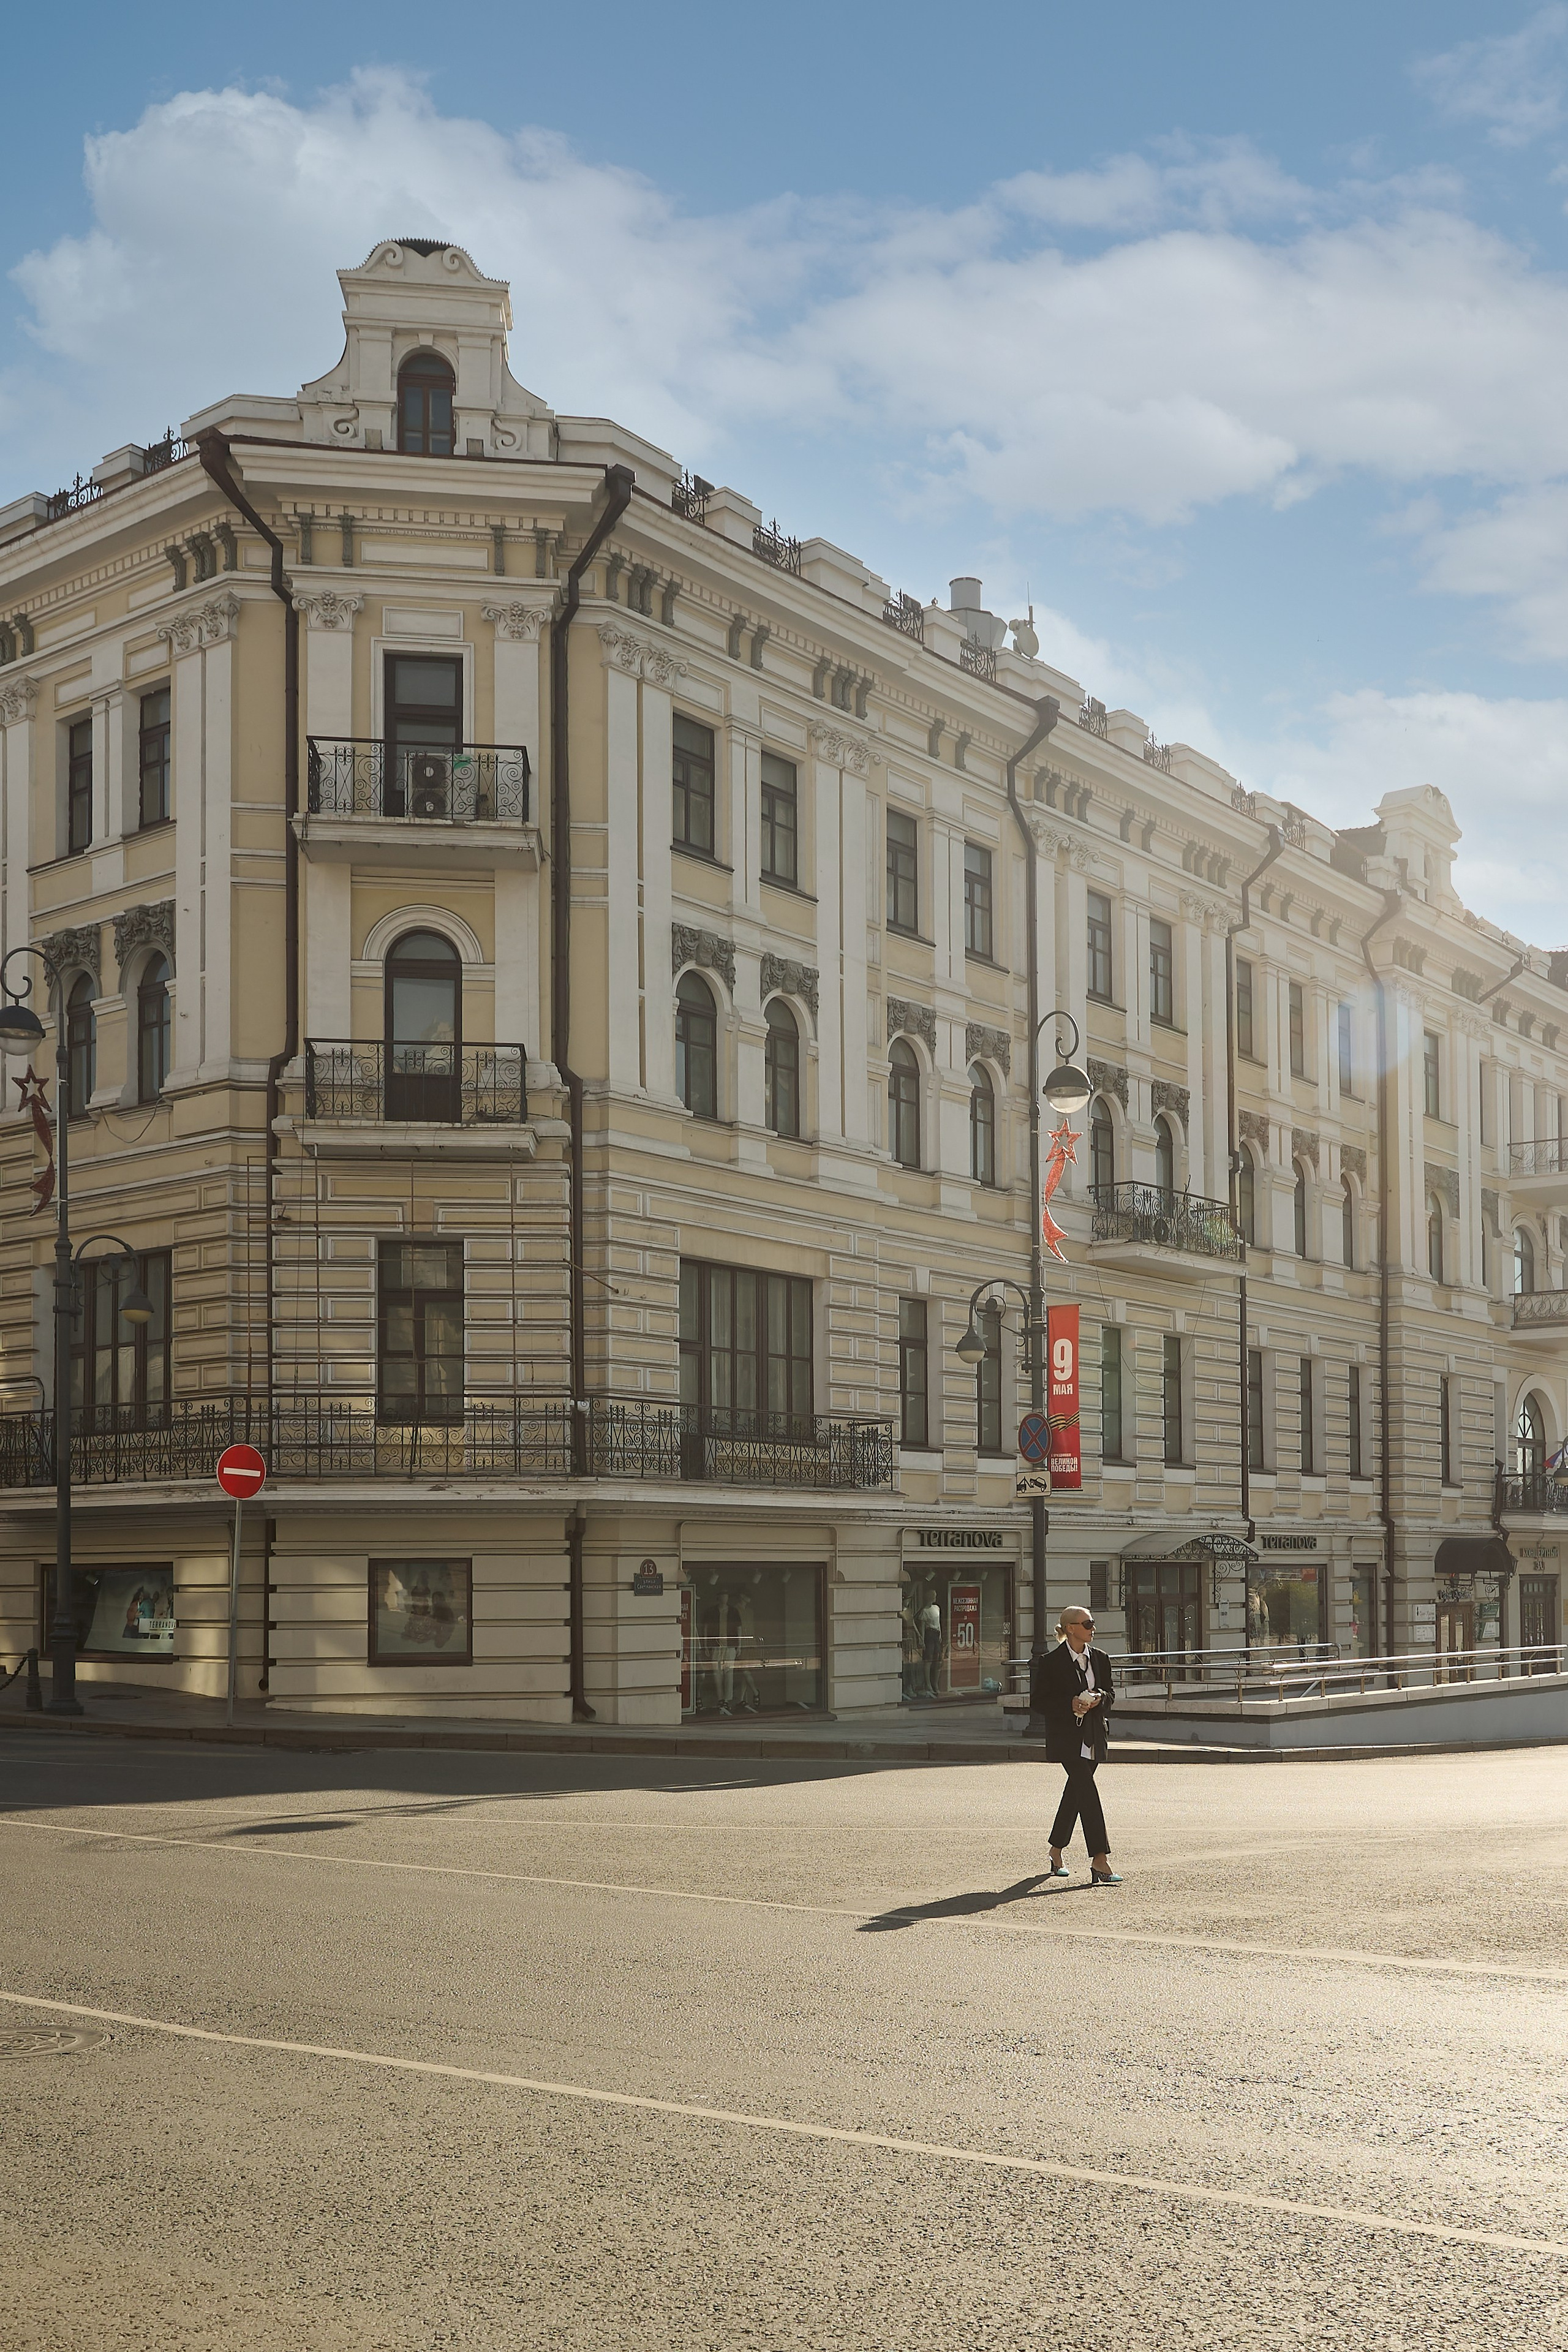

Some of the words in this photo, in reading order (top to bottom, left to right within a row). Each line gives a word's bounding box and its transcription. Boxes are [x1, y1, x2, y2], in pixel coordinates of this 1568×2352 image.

[1054, 1338, 1072, 1381] 9
[1053, 1384, 1073, 1395] МАЯ
[1050, 1457, 1077, 1465] ВЕЛИКОЙ
[1051, 1464, 1077, 1473] ПОБЕДЫ!
[644, 1563, 654, 1575] 13
